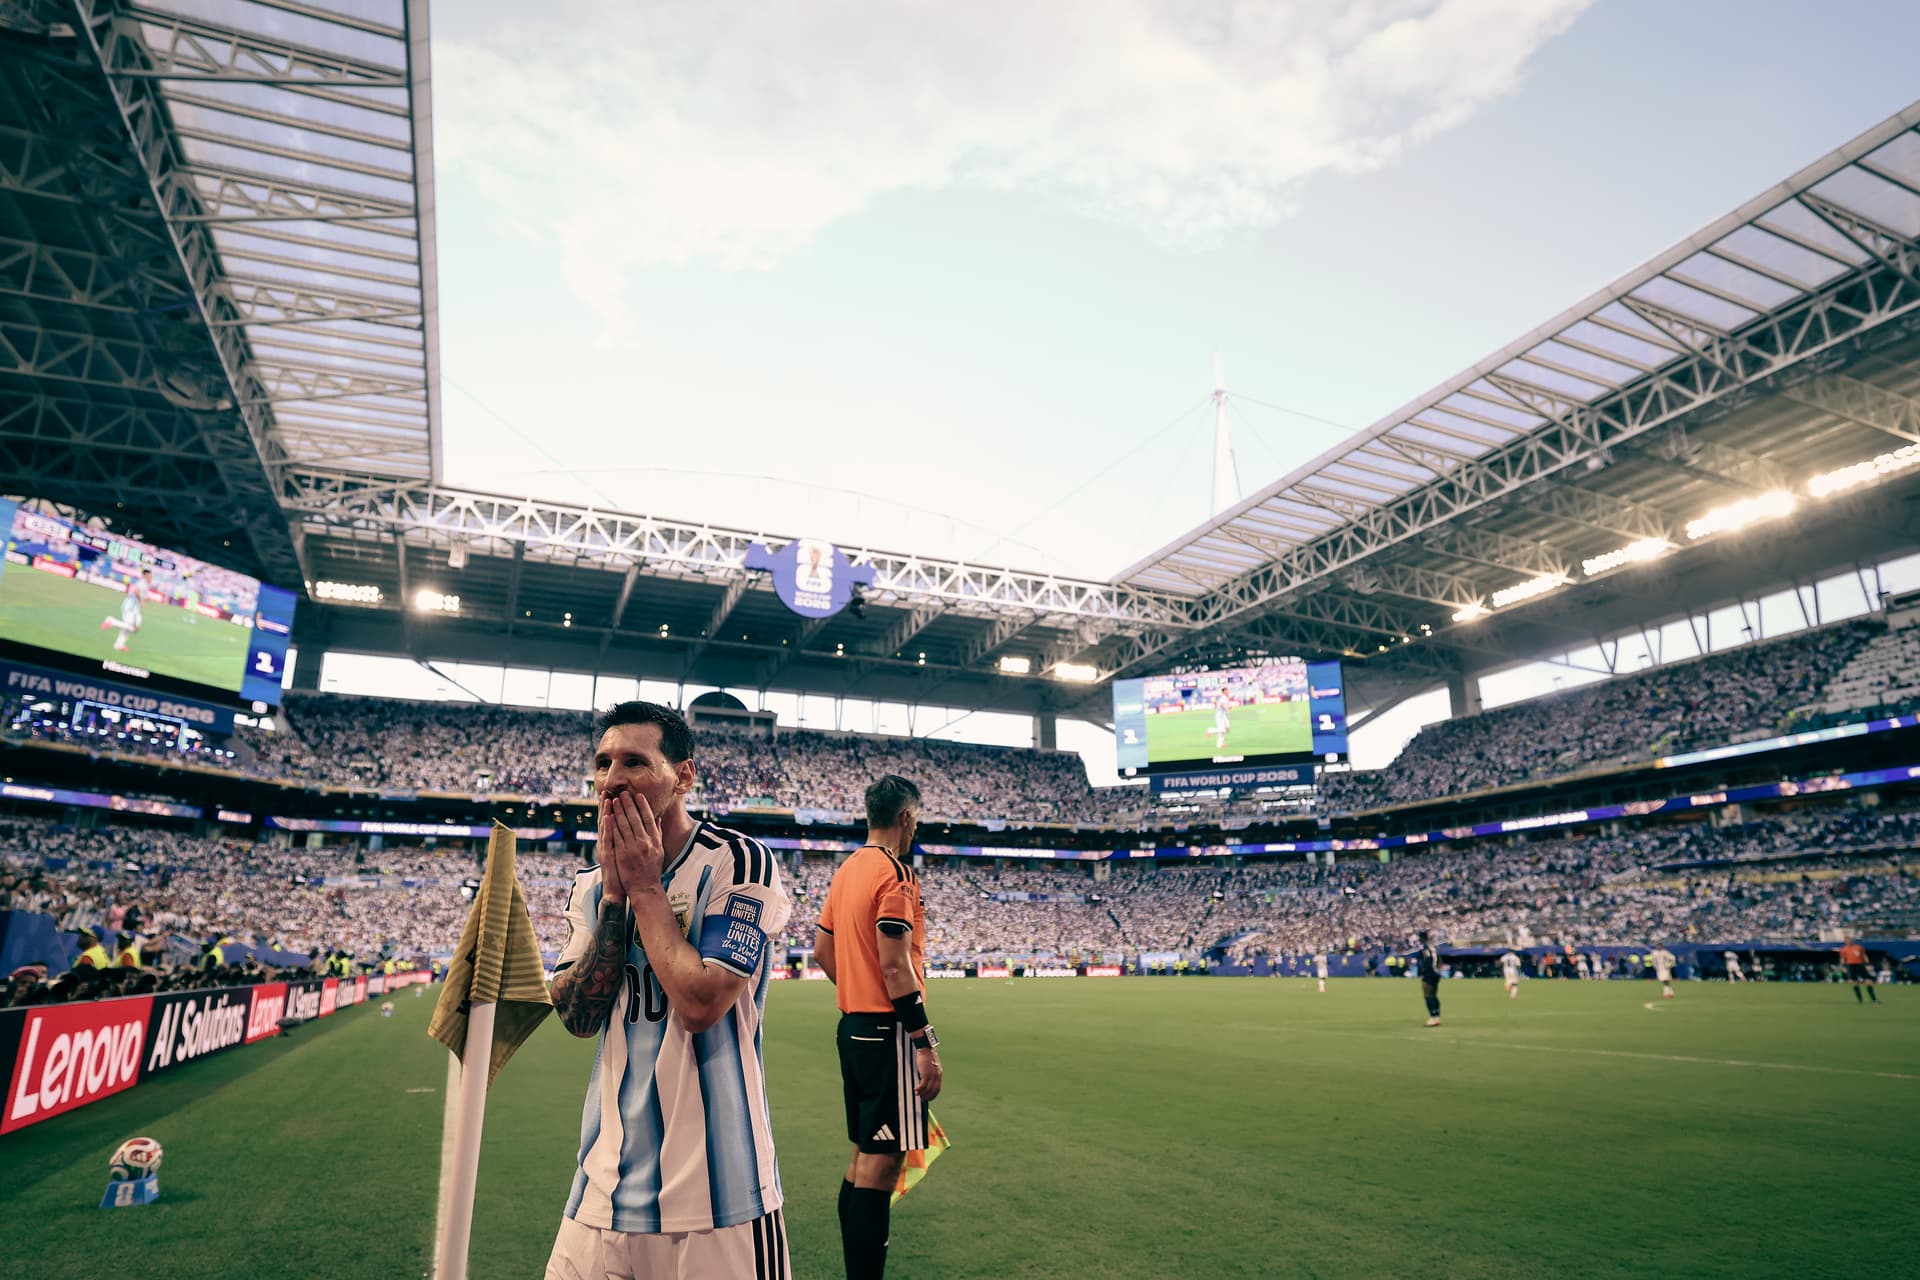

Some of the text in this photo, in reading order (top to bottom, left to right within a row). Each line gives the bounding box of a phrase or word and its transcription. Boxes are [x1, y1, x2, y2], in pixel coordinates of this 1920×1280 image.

[255, 651, 275, 673] 1
[8, 671, 215, 724] FIFA WORLD CUP 2026
[1318, 714, 1336, 731] 1
[1163, 769, 1299, 788] FIFA WORLD CUP 2026
[731, 908, 756, 922] UNITES
[733, 901, 757, 913] FOOTBALL
[726, 928, 760, 952] UNITES
[730, 920, 761, 941] FOOTBALL
[721, 939, 759, 962] the World
[1086, 966, 1121, 978] Lenovo
[147, 1002, 182, 1072] AI
[176, 993, 246, 1062] Solutions
[11, 1017, 143, 1121] Lenovo
